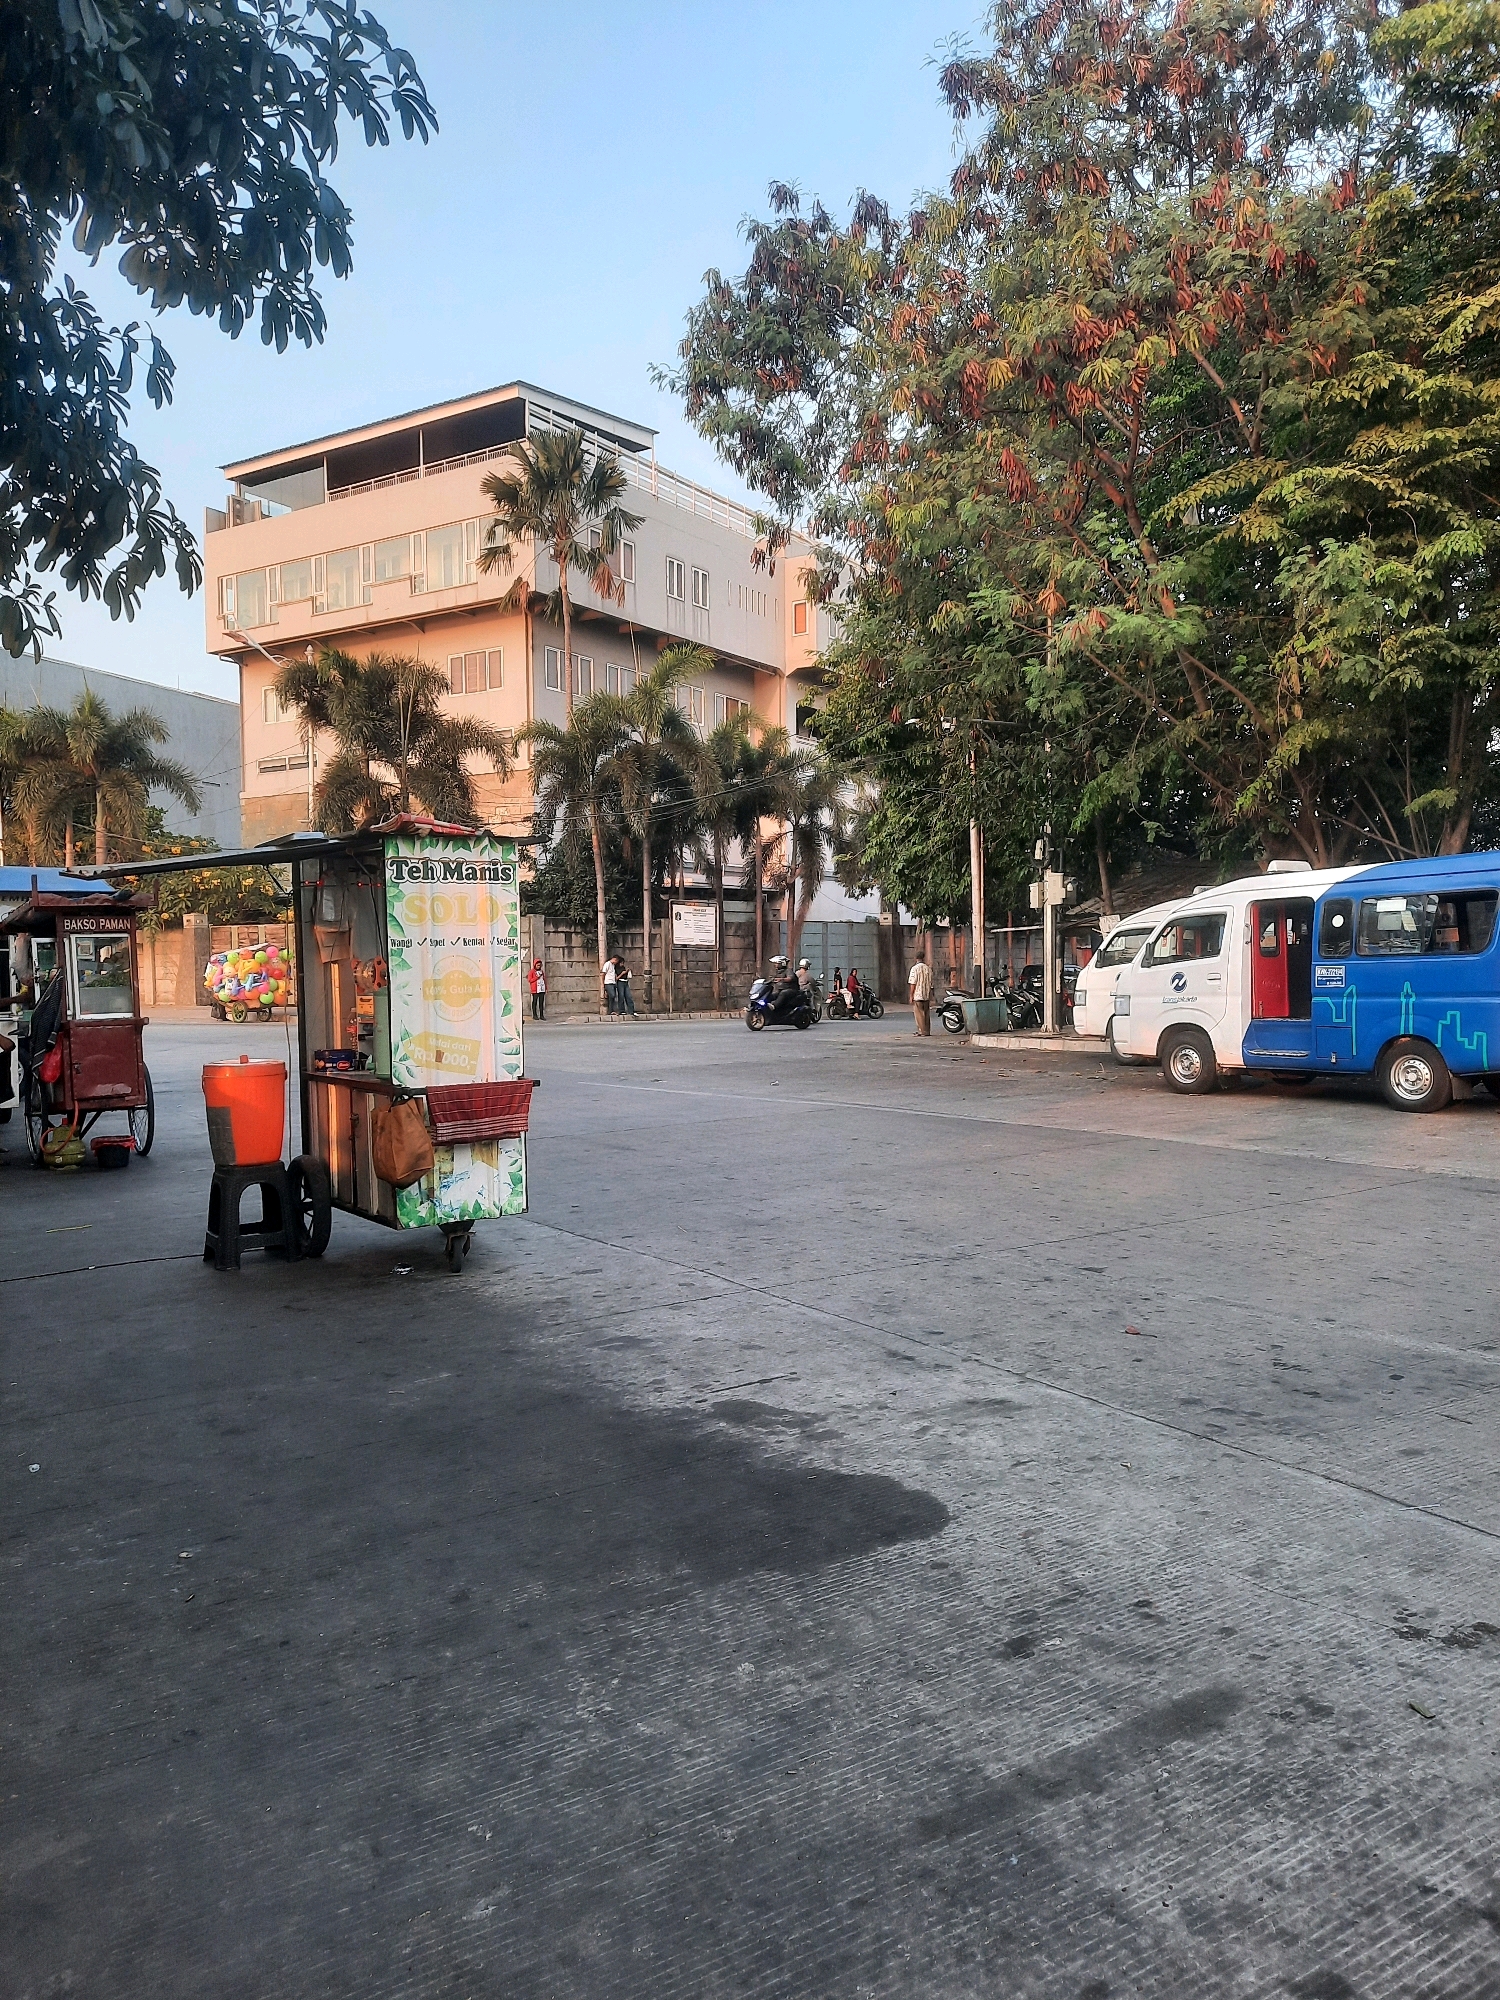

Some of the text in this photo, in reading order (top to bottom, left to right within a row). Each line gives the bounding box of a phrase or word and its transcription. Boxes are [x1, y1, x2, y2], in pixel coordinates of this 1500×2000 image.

[388, 858, 514, 882] Teh Manis
[402, 893, 500, 925] SOLO
[64, 918, 131, 930] BAKSO PAMAN
[390, 938, 413, 948] Wangi
[463, 937, 485, 947] Kental
[496, 937, 516, 947] Segar
[449, 984, 473, 994] Gula
[474, 983, 491, 993] Asli
[451, 1042, 472, 1052] dari
